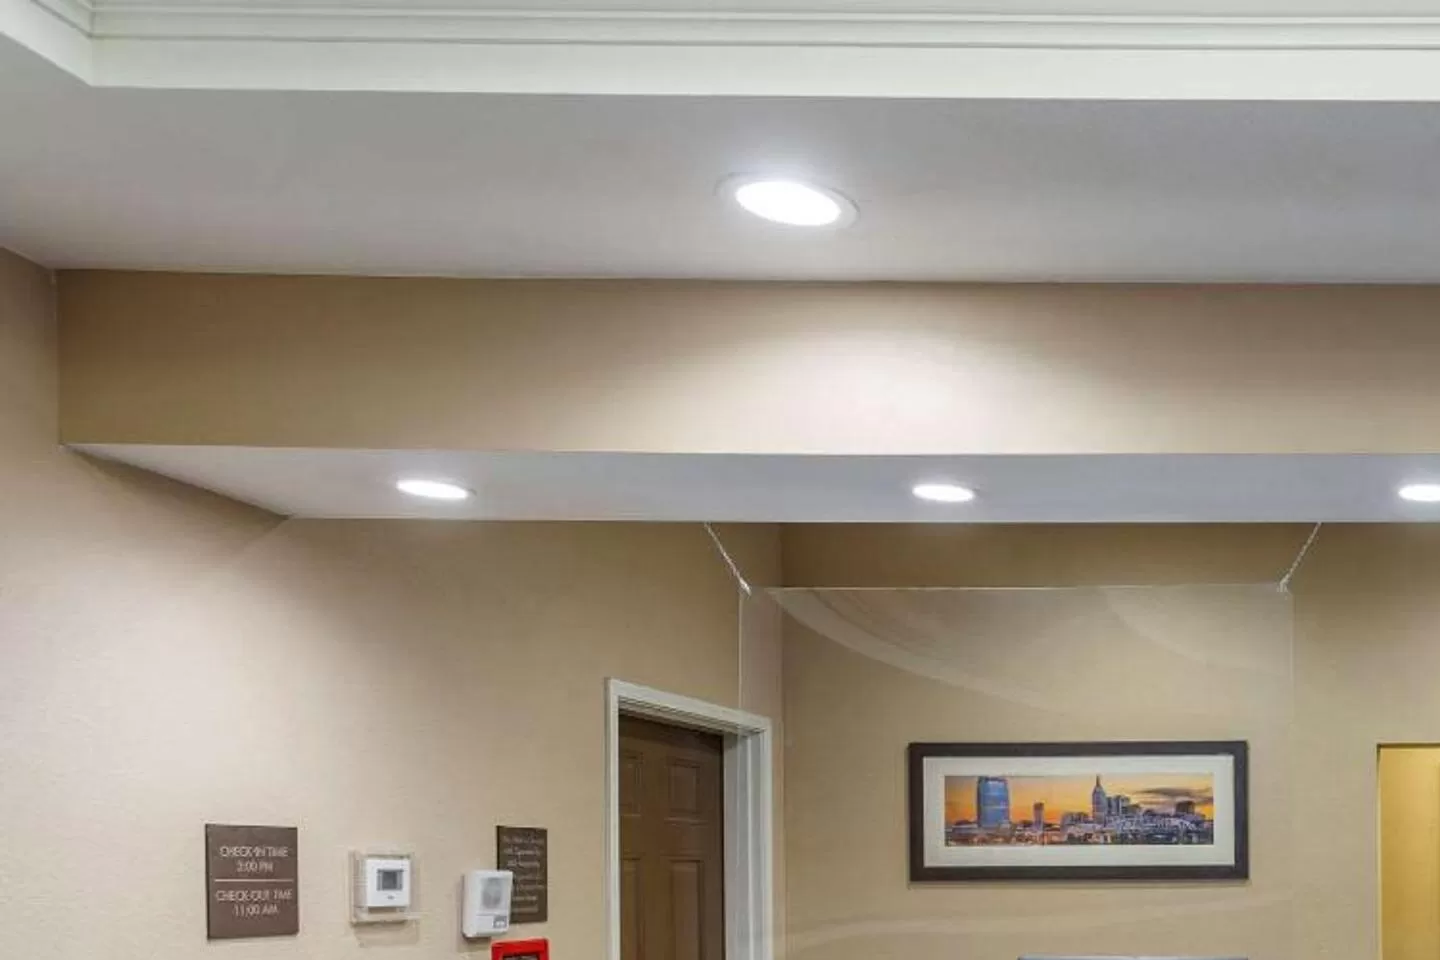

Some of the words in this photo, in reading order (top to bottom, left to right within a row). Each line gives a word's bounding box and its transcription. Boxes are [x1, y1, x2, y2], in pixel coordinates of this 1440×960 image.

[266, 846, 289, 857] TIME
[259, 861, 274, 873] PM
[273, 889, 293, 900] TIME
[234, 904, 260, 916] 11:00
[261, 904, 279, 915] AM
